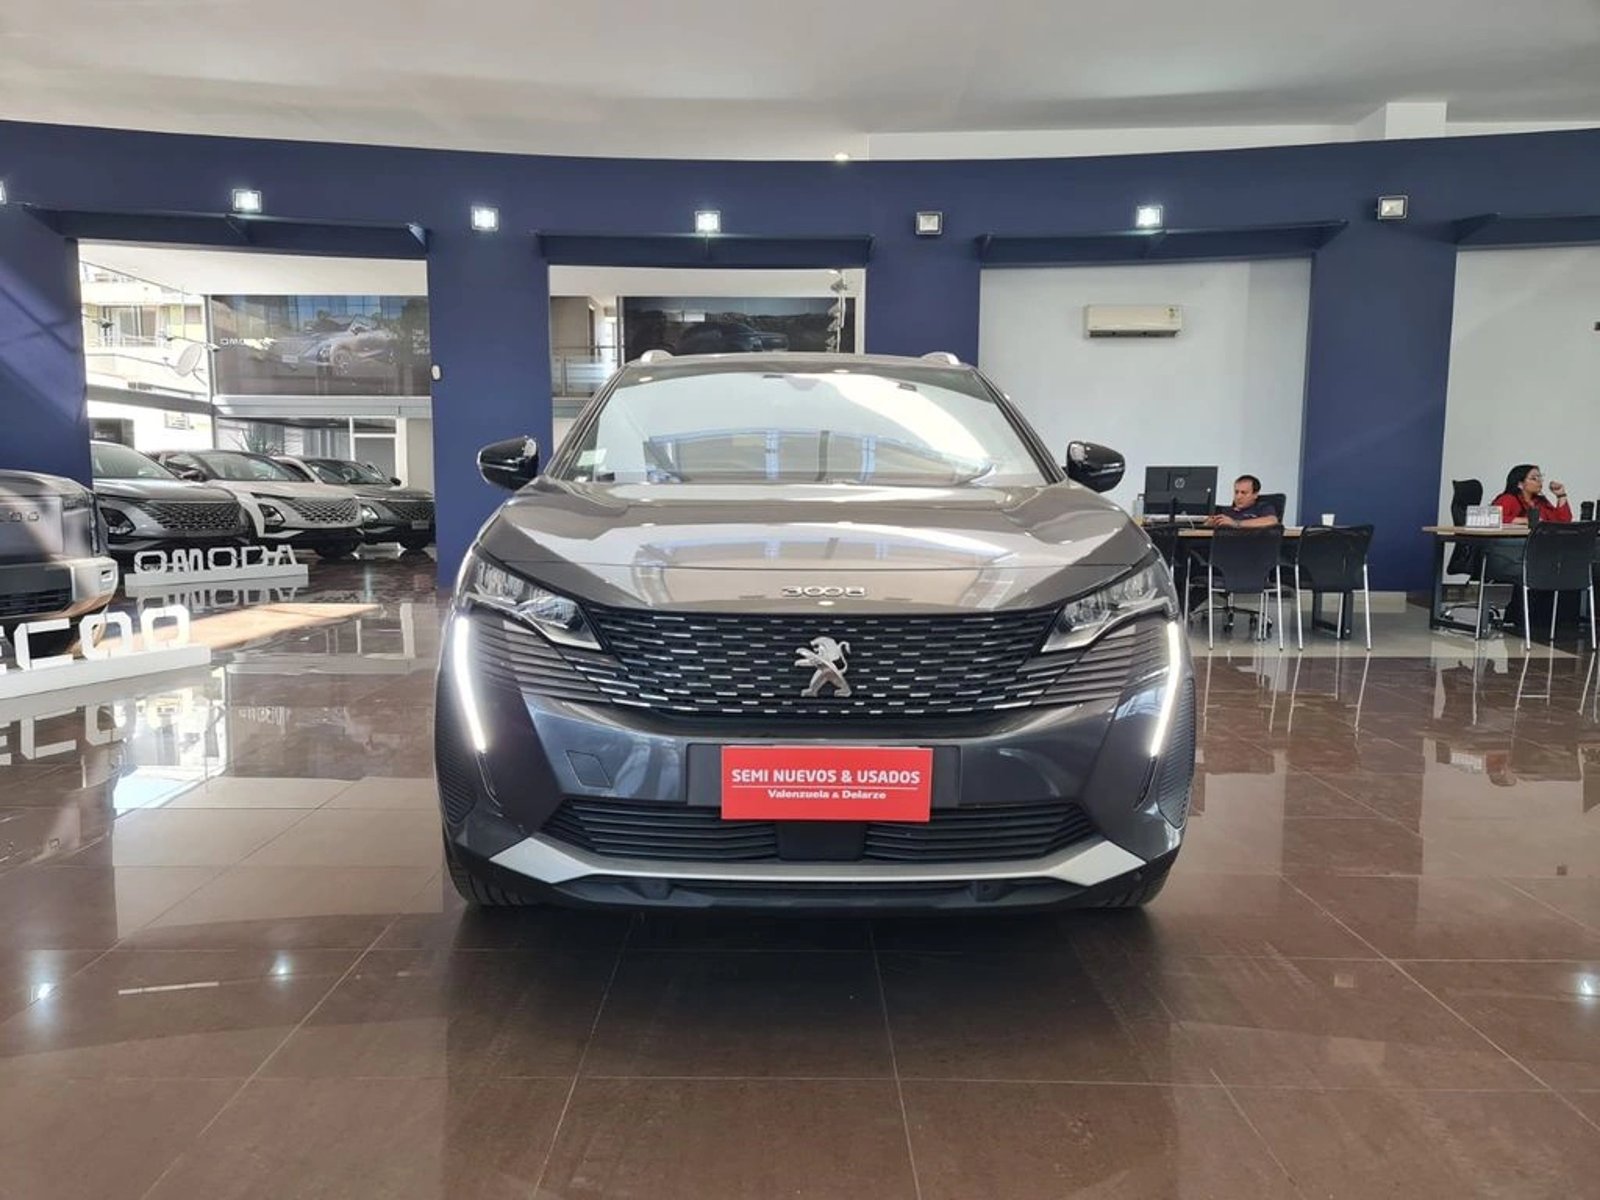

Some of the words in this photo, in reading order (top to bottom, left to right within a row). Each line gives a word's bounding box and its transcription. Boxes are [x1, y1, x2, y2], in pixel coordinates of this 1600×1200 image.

[133, 545, 297, 574] OMODA
[0, 604, 191, 675] COO
[731, 769, 769, 783] SEMI
[773, 769, 837, 783] NUEVOS
[841, 769, 852, 784] &
[857, 770, 920, 784] USADOS
[767, 789, 830, 799] Valenzuela
